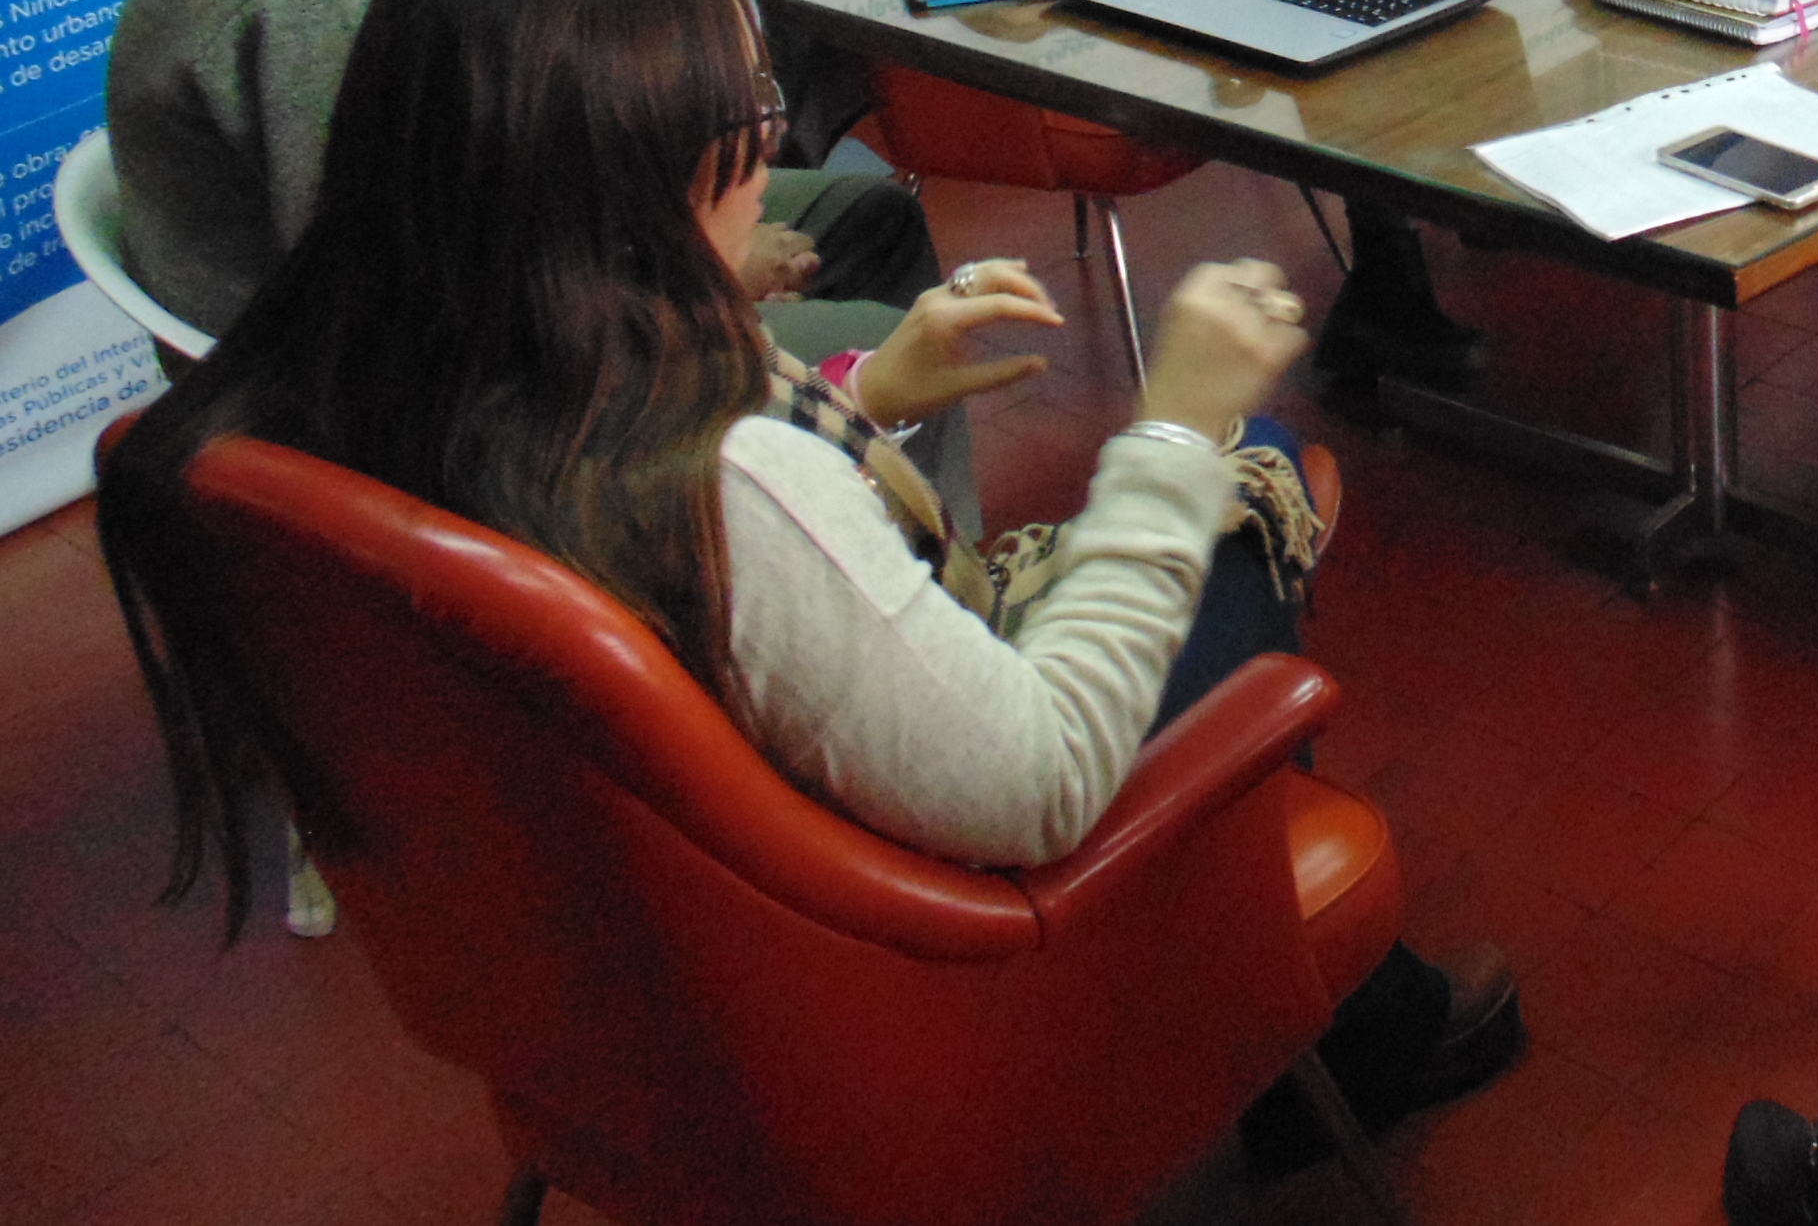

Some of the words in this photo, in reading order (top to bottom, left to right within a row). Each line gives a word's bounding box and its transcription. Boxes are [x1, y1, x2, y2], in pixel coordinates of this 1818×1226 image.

[10, 64, 42, 87] de
[13, 142, 71, 179] obra
[8, 251, 38, 275] de
[56, 356, 88, 379] del
[23, 372, 108, 415] Públicas
[118, 379, 148, 400] de
